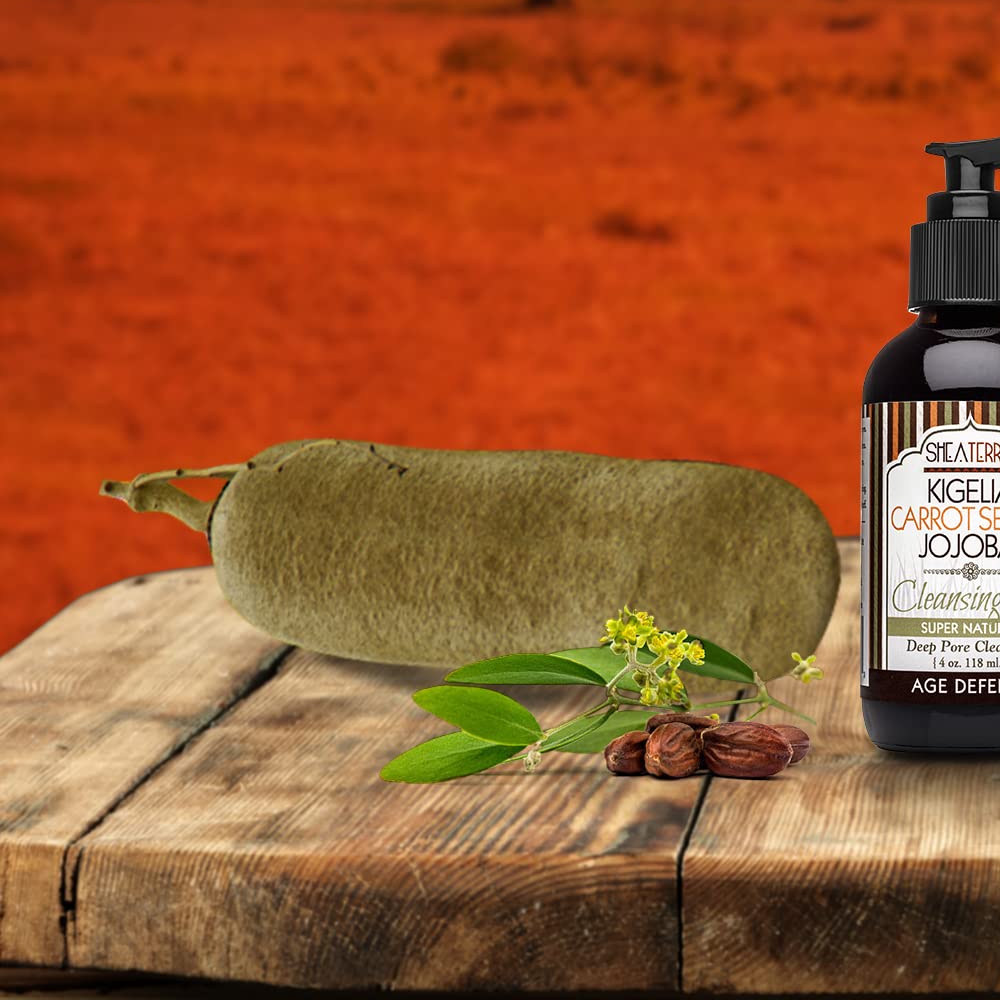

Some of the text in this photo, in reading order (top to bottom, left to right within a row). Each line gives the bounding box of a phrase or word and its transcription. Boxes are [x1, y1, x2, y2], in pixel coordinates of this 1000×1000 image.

[890, 506, 976, 531] CARROT
[920, 621, 959, 634] SUPER
[906, 639, 936, 655] Deep
[941, 639, 970, 653] Pore
[947, 660, 962, 668] oz.
[965, 658, 984, 668] 118
[911, 677, 948, 694] AGE
